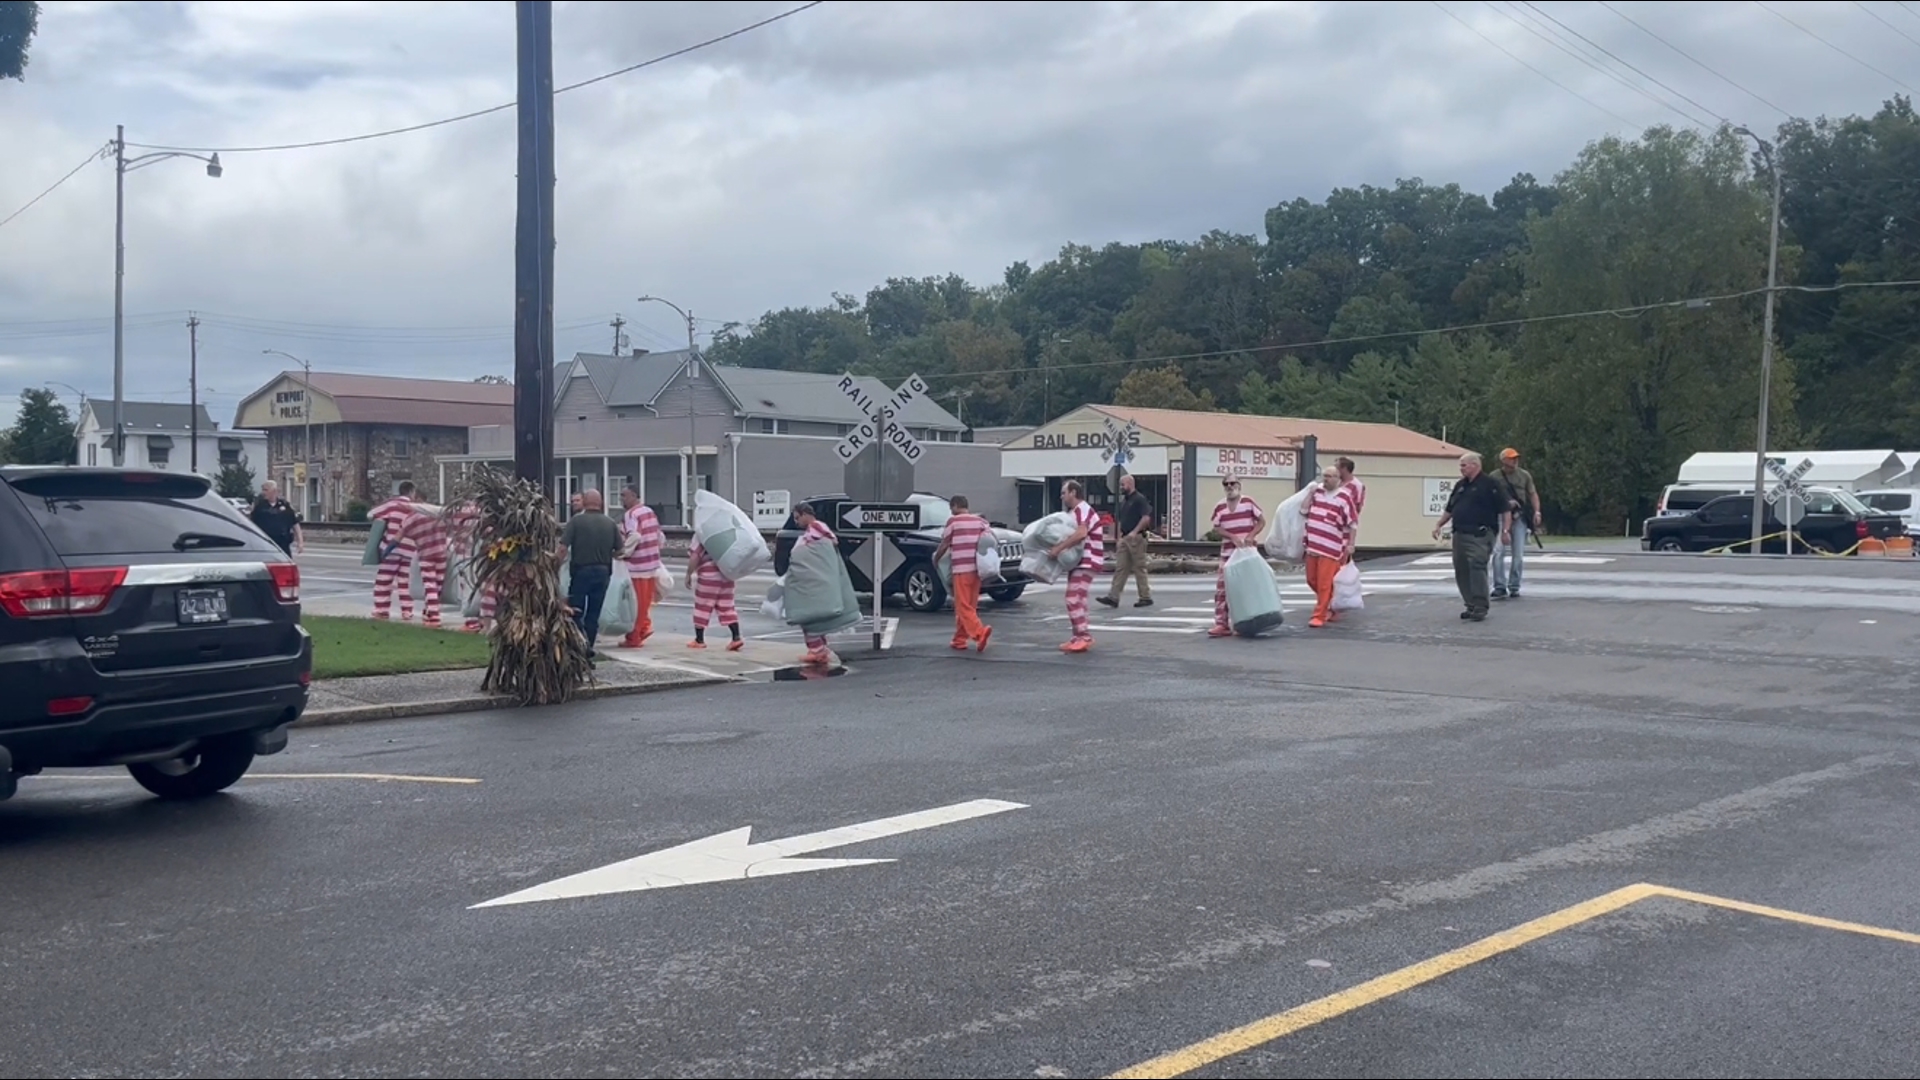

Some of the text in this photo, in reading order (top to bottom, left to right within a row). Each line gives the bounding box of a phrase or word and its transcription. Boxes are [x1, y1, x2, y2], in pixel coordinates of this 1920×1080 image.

[280, 406, 301, 419] POLICE
[838, 376, 920, 459] RAIL ROAD
[1034, 432, 1140, 448] BAIL BONS
[1101, 419, 1136, 461] CROING
[1219, 449, 1294, 467] BAIL BONDS
[862, 511, 911, 522] ONE WAY
